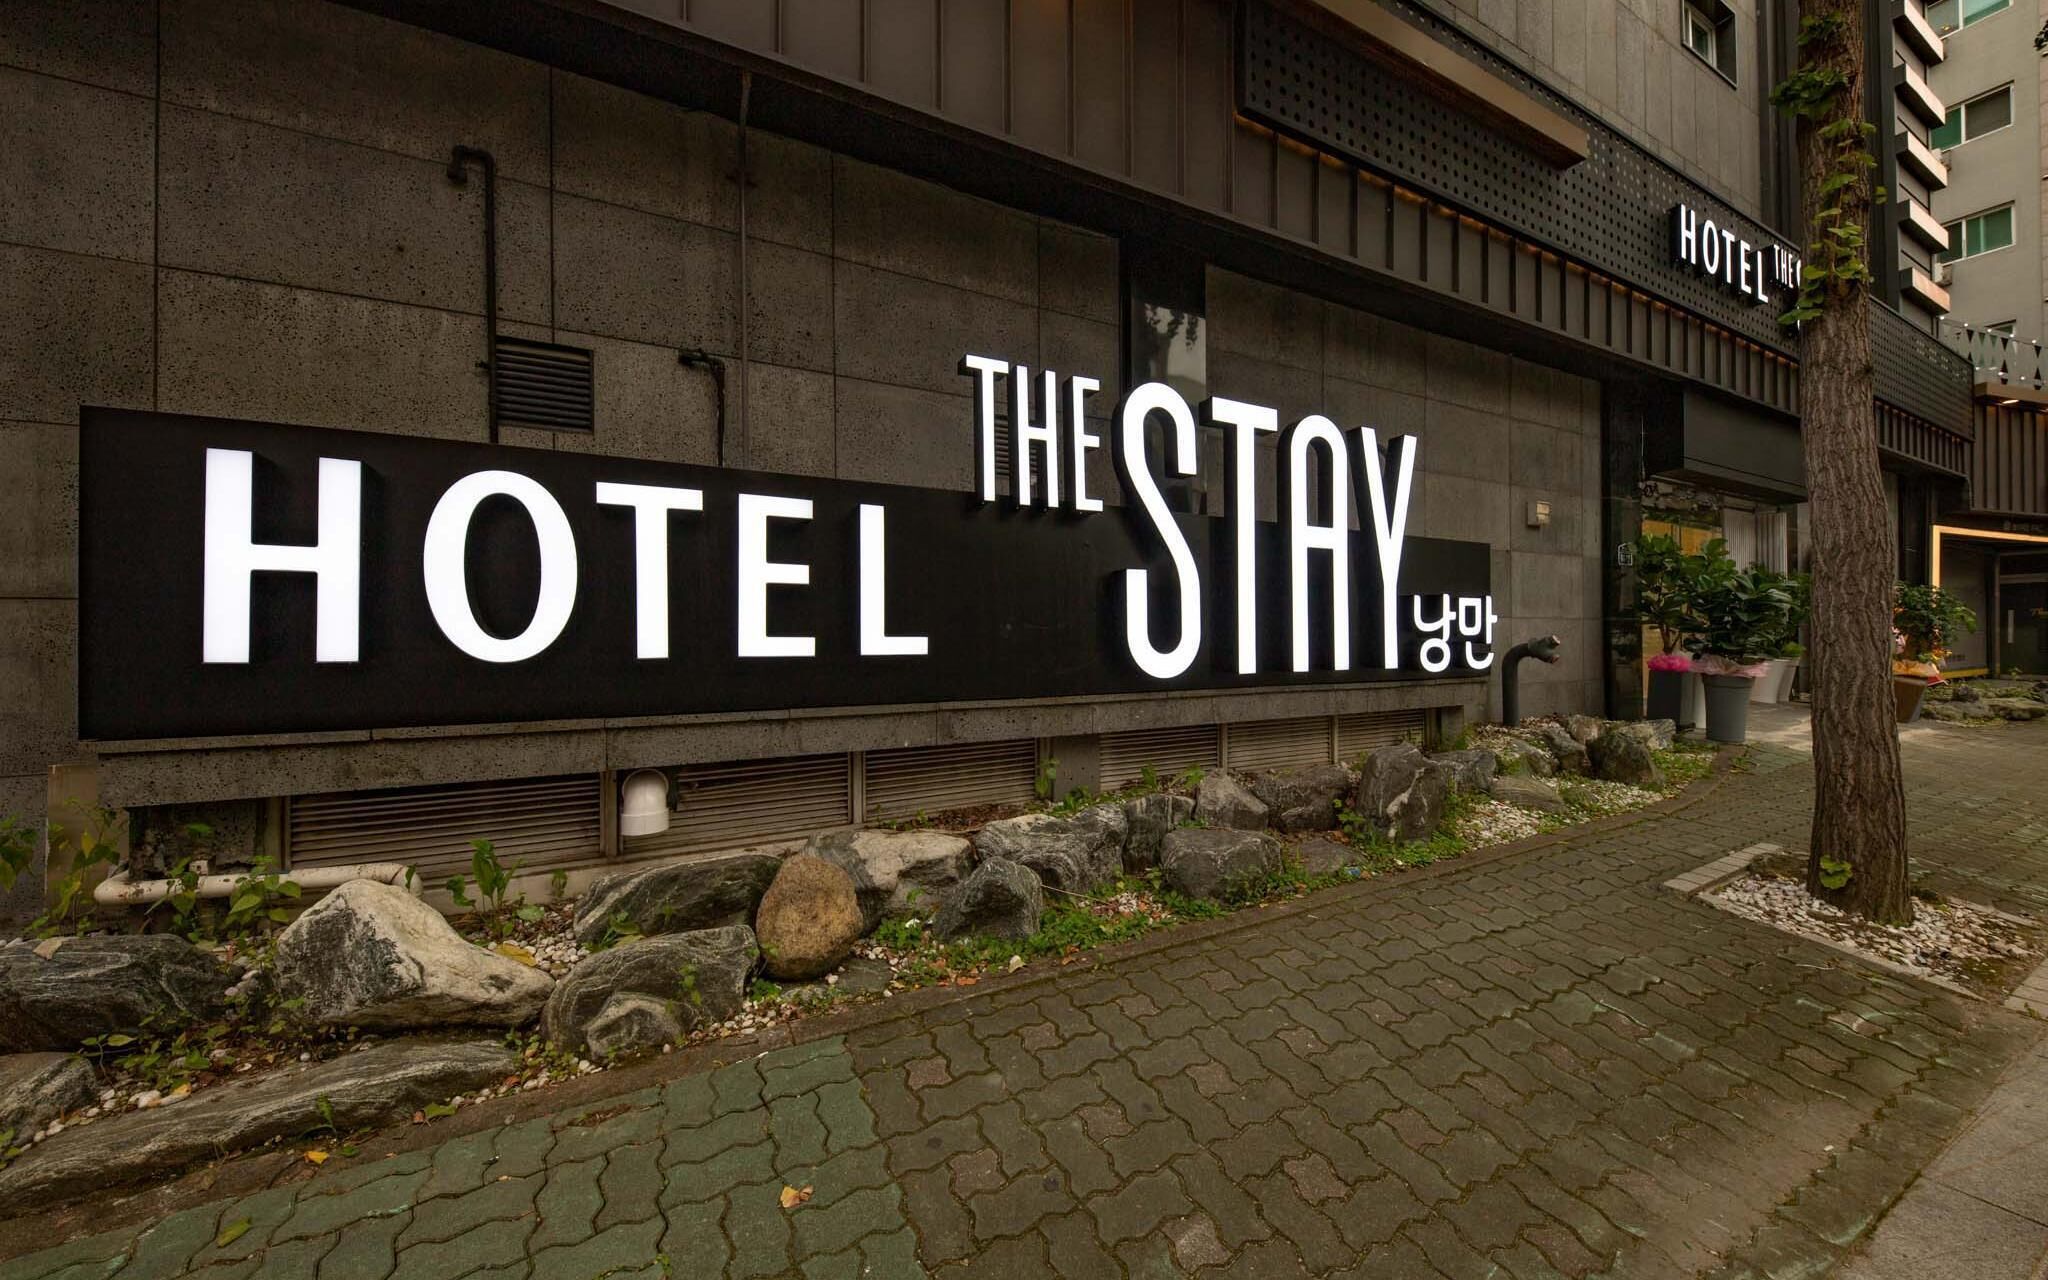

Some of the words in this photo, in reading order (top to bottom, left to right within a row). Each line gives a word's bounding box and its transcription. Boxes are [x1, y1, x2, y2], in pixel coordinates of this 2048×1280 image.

[1680, 203, 1769, 304] HOTEL
[1773, 244, 1794, 289] THE
[202, 447, 930, 664] HOTEL
[965, 354, 1104, 512] THE
[1122, 381, 1418, 680] STAY
[1413, 593, 1498, 673] 낭만
